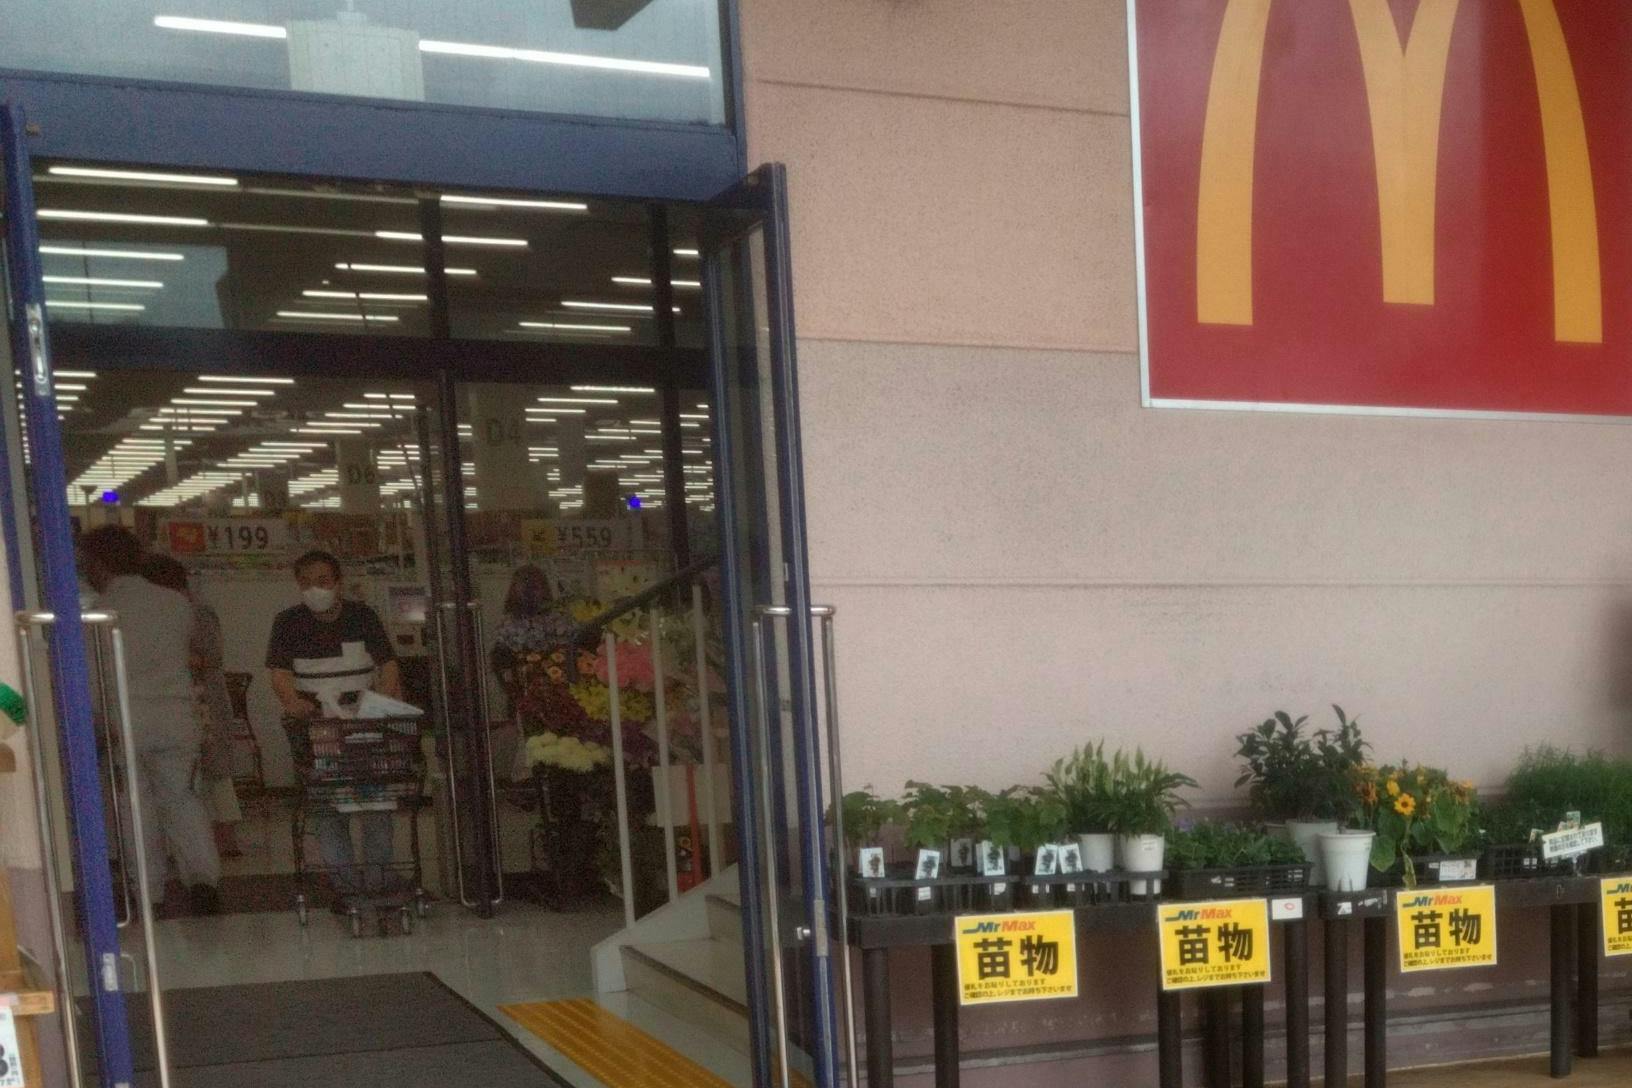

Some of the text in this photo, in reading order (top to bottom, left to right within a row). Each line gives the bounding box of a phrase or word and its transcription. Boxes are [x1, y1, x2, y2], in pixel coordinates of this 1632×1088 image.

[1165, 908, 1232, 921] MrMax
[1402, 895, 1463, 908] MrMax
[962, 921, 1036, 934] MrMax
[1411, 908, 1482, 950] 苗物
[973, 934, 1059, 980] 苗物
[1175, 922, 1254, 965] 苗物
